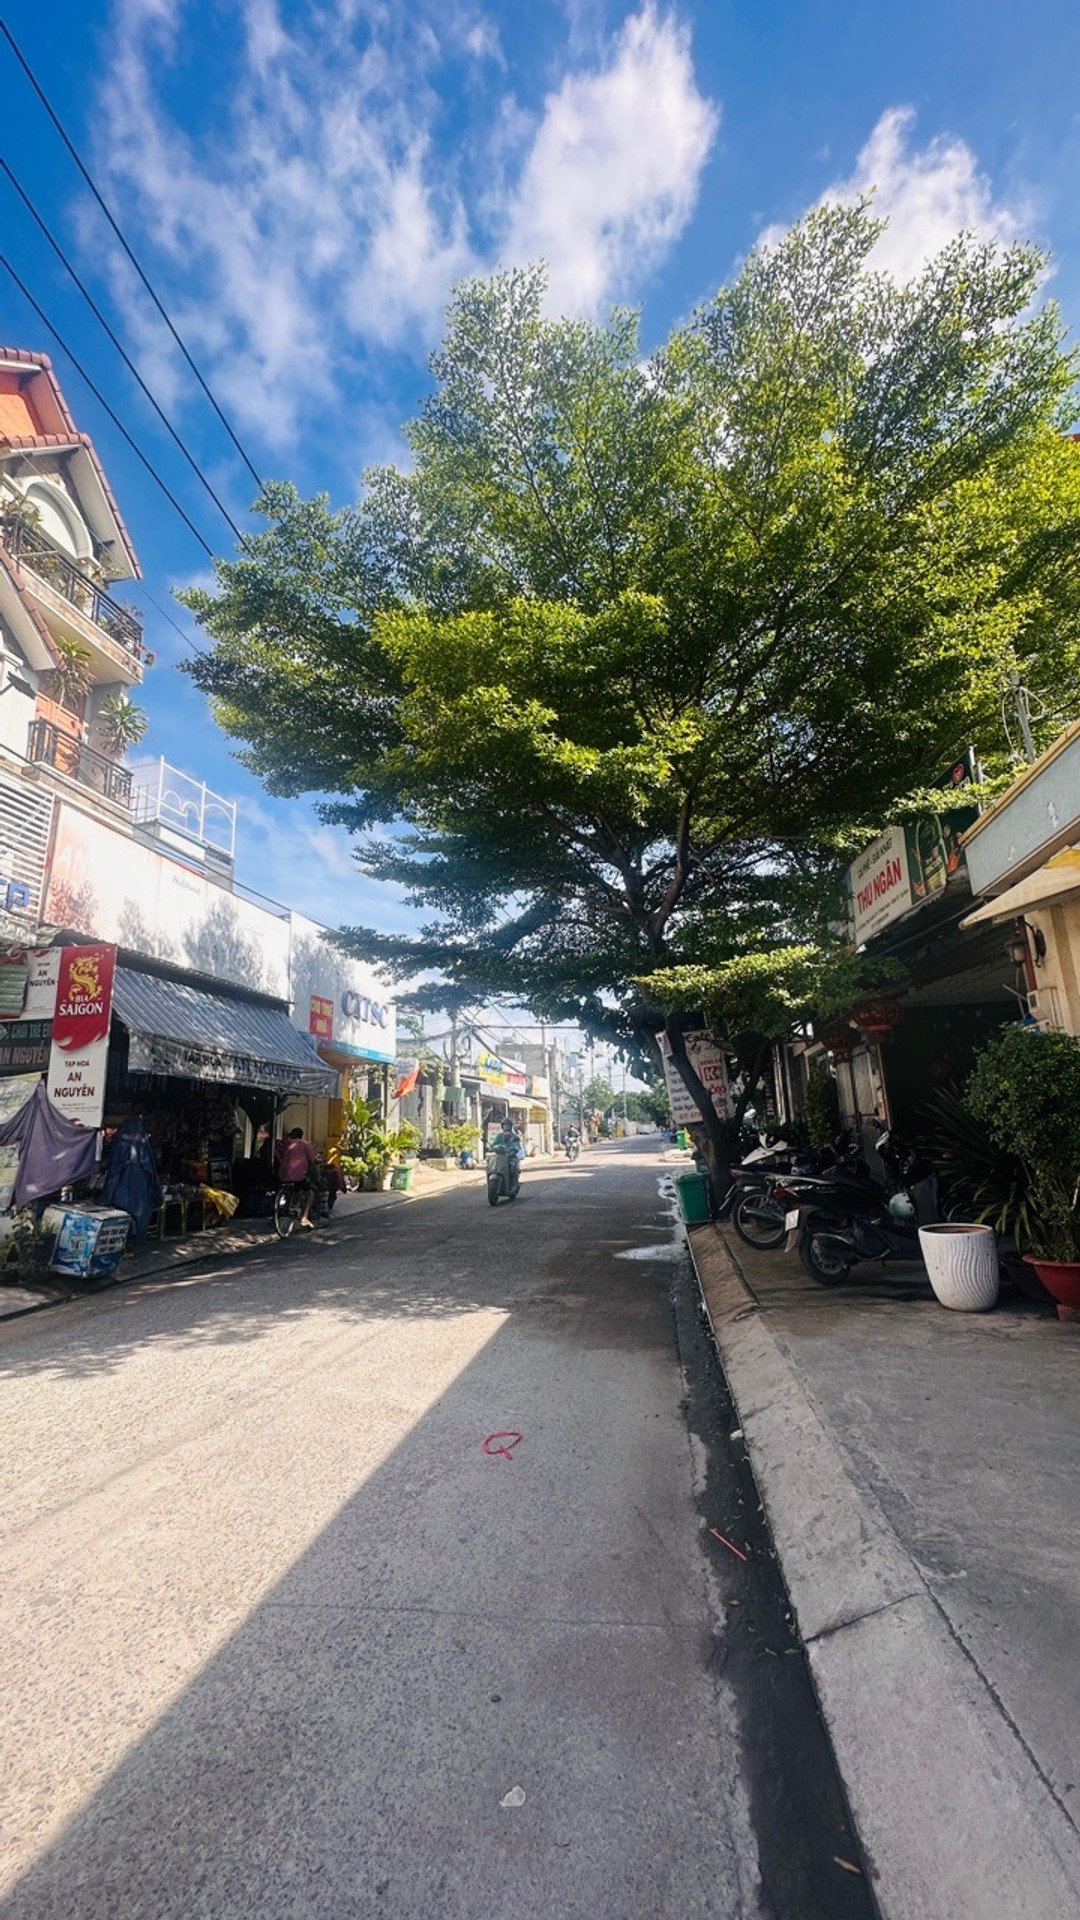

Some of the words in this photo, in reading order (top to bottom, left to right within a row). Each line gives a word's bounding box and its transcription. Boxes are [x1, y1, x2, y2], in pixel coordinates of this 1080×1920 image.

[857, 882, 873, 914] THU
[873, 857, 902, 900] NGÂN
[75, 994, 89, 1003] BIA
[59, 1002, 103, 1016] SAIGON
[67, 1072, 82, 1082] AN
